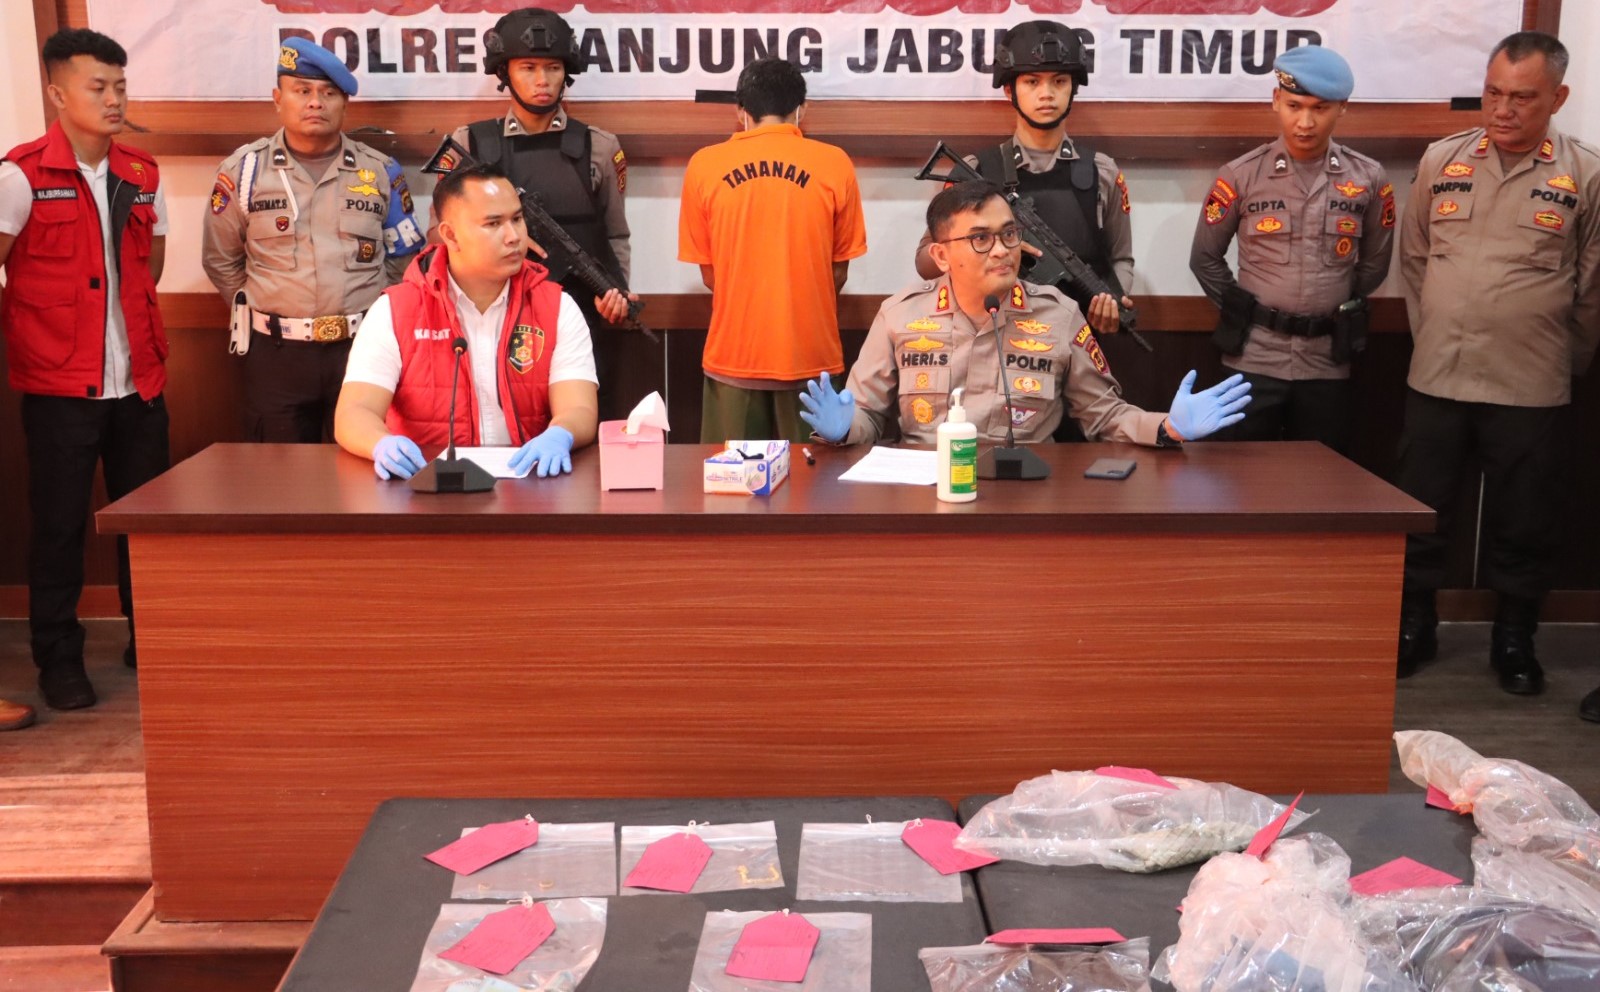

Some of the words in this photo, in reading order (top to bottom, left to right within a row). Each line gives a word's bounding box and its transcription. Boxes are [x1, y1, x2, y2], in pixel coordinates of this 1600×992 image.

[279, 27, 500, 73] OLRE
[566, 27, 823, 74] ANJUNG
[847, 28, 1095, 74] JABU
[722, 160, 810, 189] TAHANAN
[1432, 182, 1473, 195] DARPIN
[1247, 200, 1286, 213] CIPTA
[1530, 188, 1577, 209] POLRI
[1330, 200, 1365, 214] POLRI
[901, 353, 949, 367] HERI.S
[1006, 353, 1053, 372] POLRI
